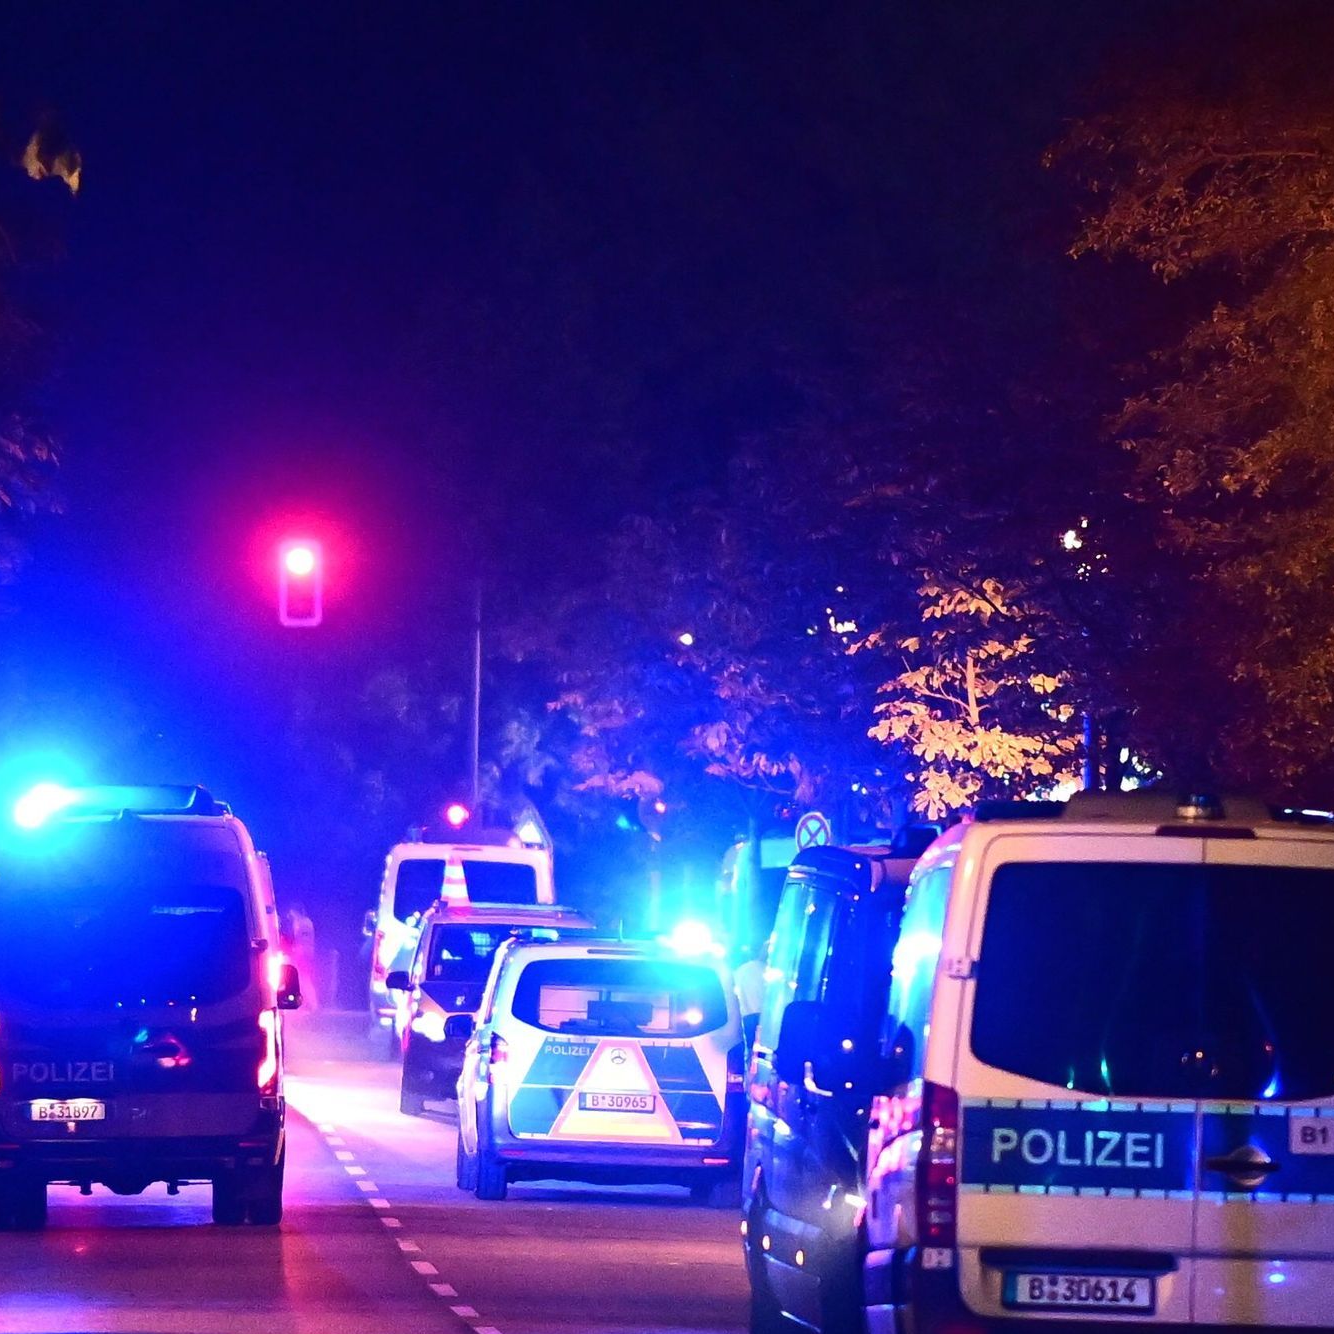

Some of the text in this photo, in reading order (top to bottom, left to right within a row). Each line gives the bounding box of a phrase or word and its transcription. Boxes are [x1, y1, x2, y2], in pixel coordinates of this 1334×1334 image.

[544, 1044, 590, 1057] POLIZEI
[12, 1061, 115, 1083] POLIZEI
[607, 1095, 648, 1109] 30965
[1300, 1125, 1329, 1145] B1
[992, 1128, 1165, 1169] POLIZEI
[1062, 1277, 1138, 1303] 30614
